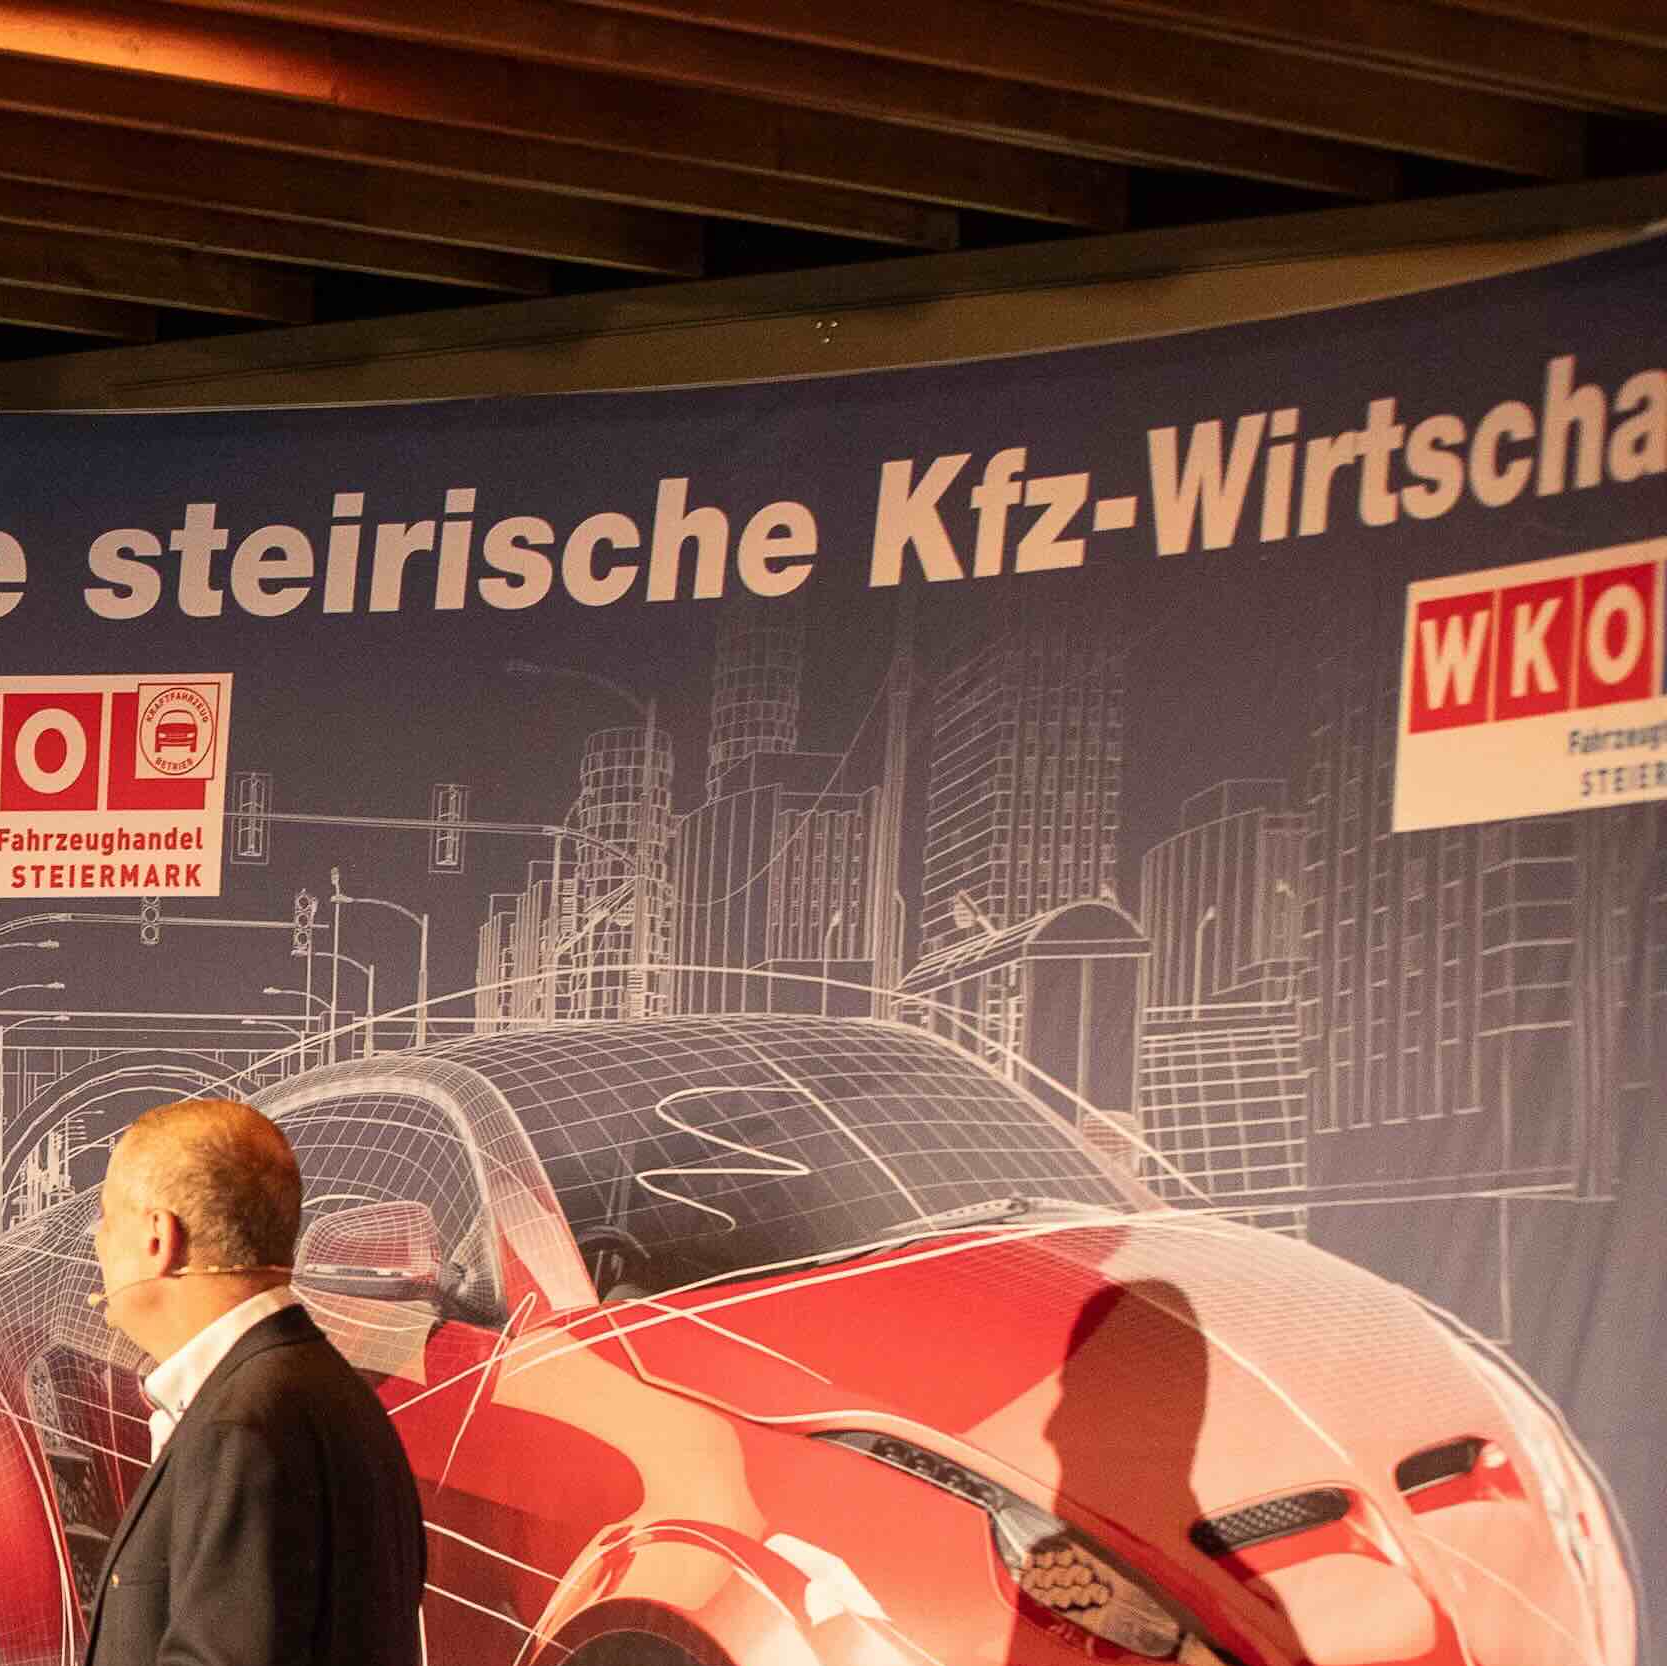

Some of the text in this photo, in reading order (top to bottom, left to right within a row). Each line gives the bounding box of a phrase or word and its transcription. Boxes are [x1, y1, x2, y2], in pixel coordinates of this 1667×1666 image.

[84, 478, 819, 619] steirische
[1420, 583, 1647, 711] WKO
[10, 862, 202, 890] STEIERMARK
